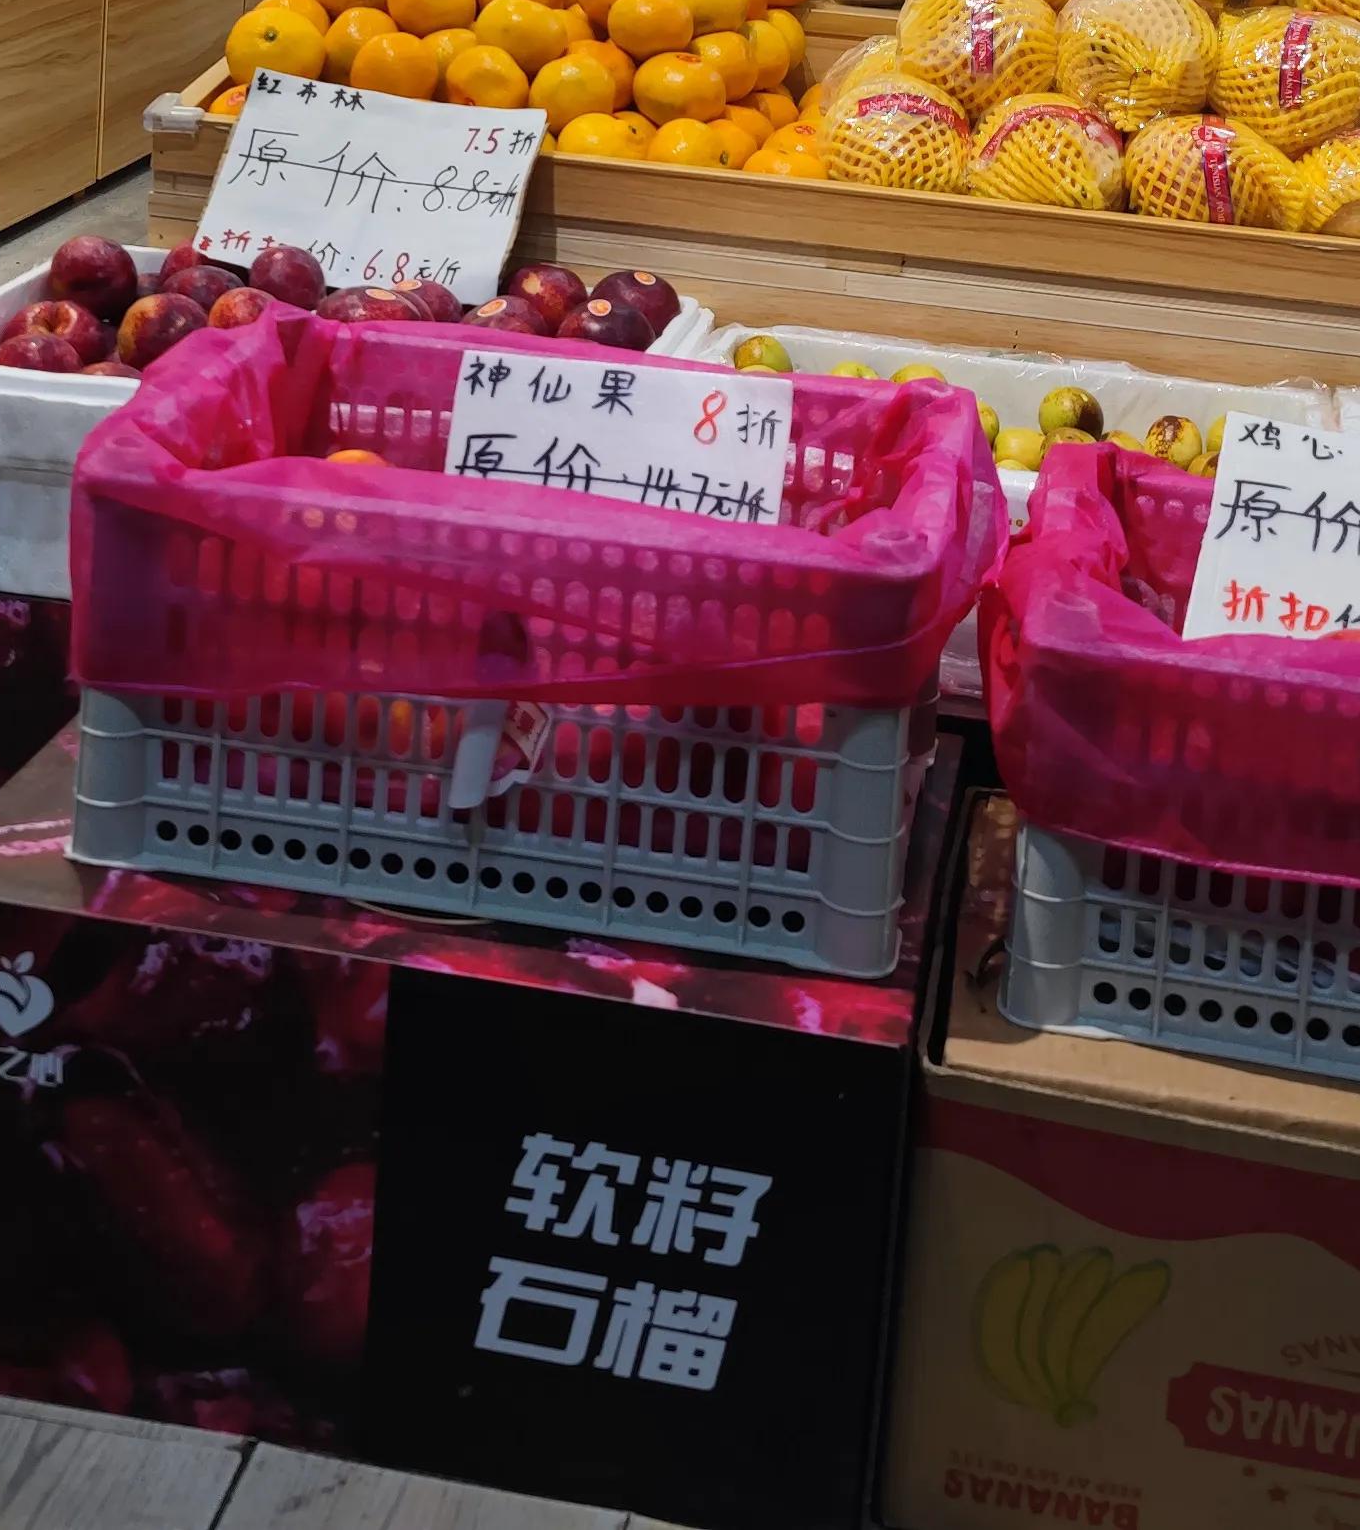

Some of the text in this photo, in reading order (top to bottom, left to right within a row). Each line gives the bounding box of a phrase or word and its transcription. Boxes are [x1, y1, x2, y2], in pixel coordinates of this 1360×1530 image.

[256, 72, 366, 111] 红布林
[464, 126, 537, 156] 7.5折
[227, 128, 520, 218] 原价:8.8元/斤
[463, 355, 636, 416] 神仙果
[693, 389, 783, 449] 8折
[503, 1131, 774, 1268] 软籽
[473, 1255, 739, 1392] 石榴
[943, 1467, 1140, 1530] BANANAS
